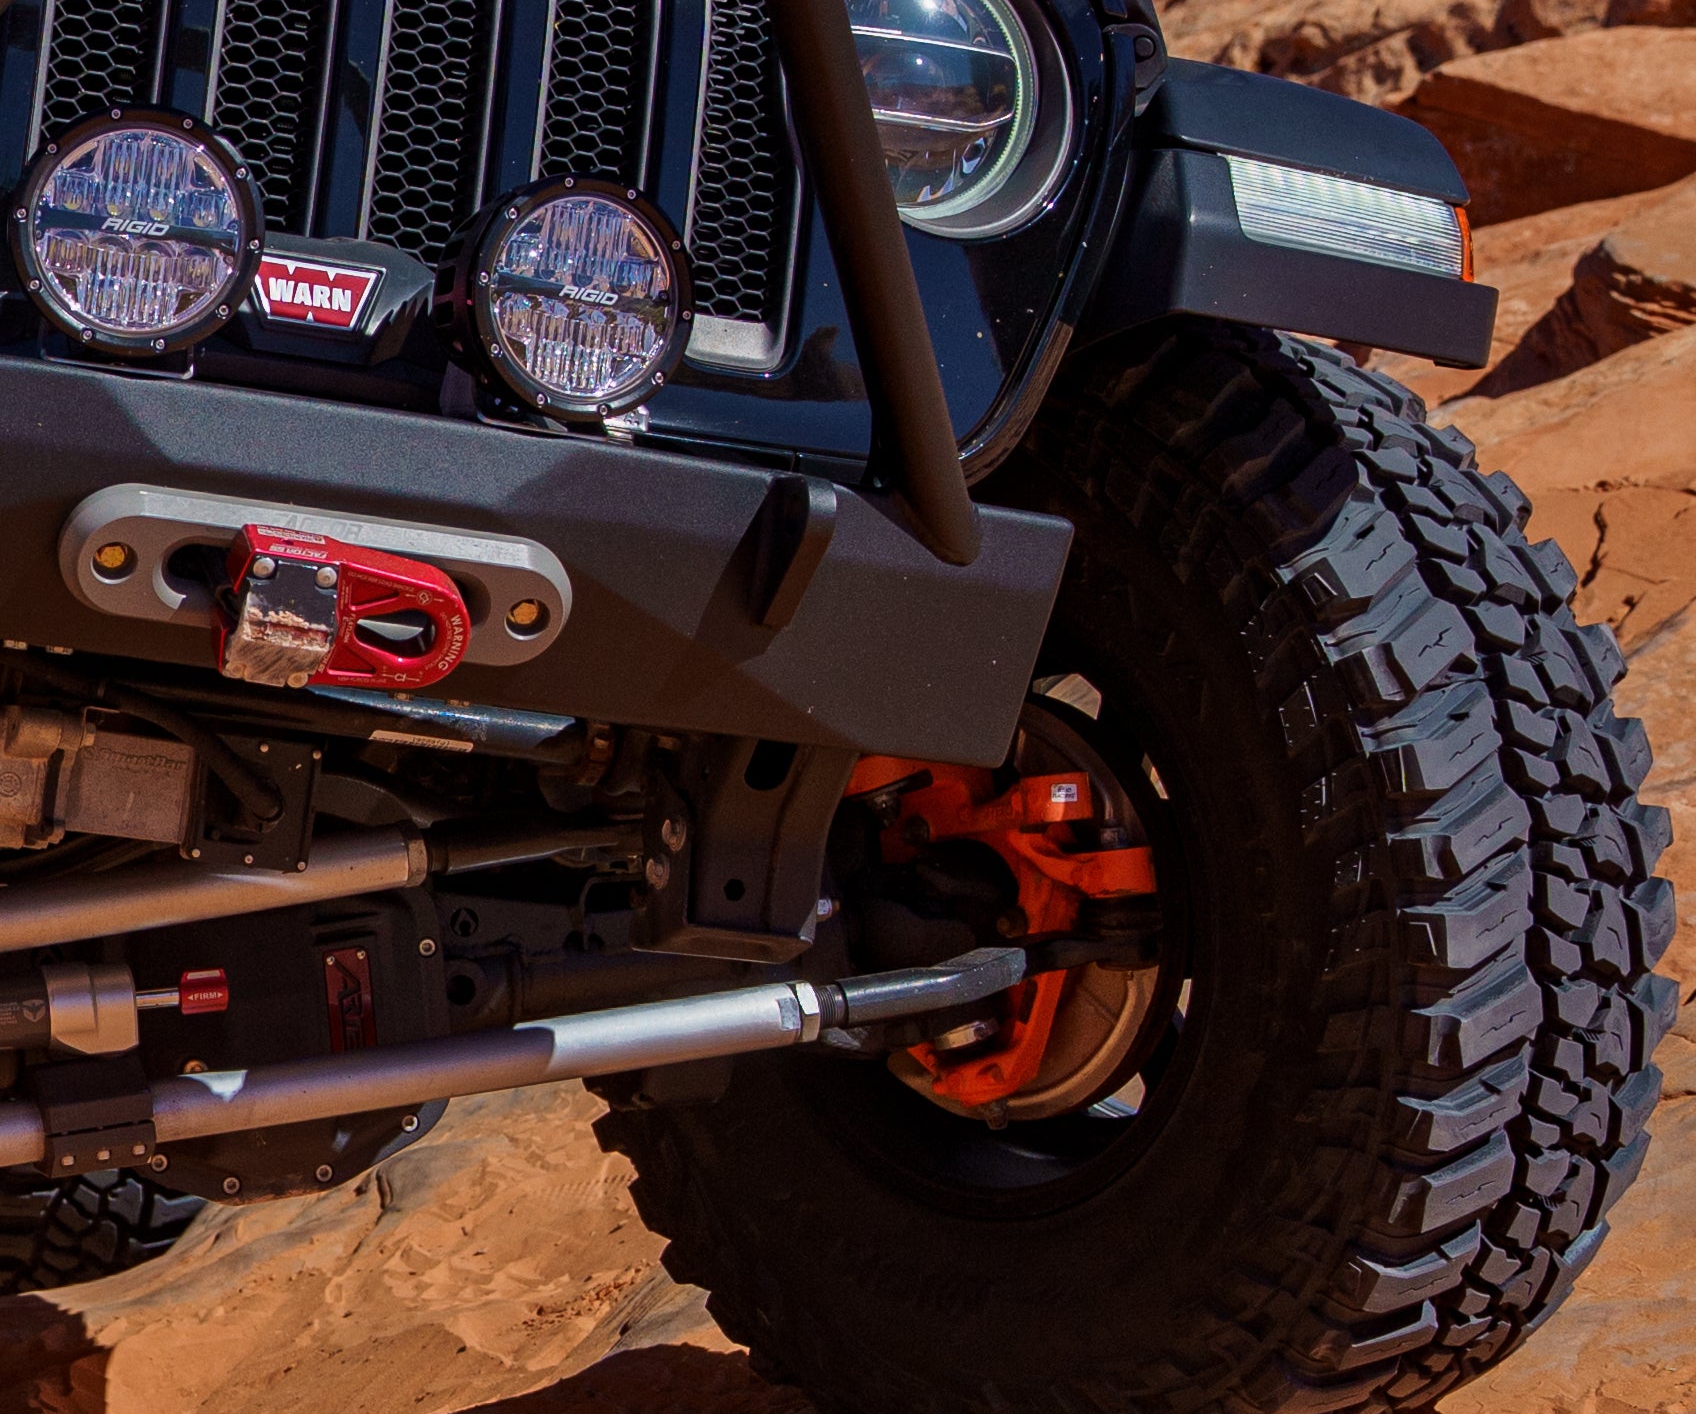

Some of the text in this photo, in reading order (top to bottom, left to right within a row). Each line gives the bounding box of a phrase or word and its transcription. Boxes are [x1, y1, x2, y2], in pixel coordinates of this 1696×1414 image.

[101, 217, 170, 237] RIGID
[268, 277, 351, 312] WARN
[558, 285, 619, 306] RIGID
[438, 614, 464, 671] WARNING
[193, 991, 218, 1002] FIRM
